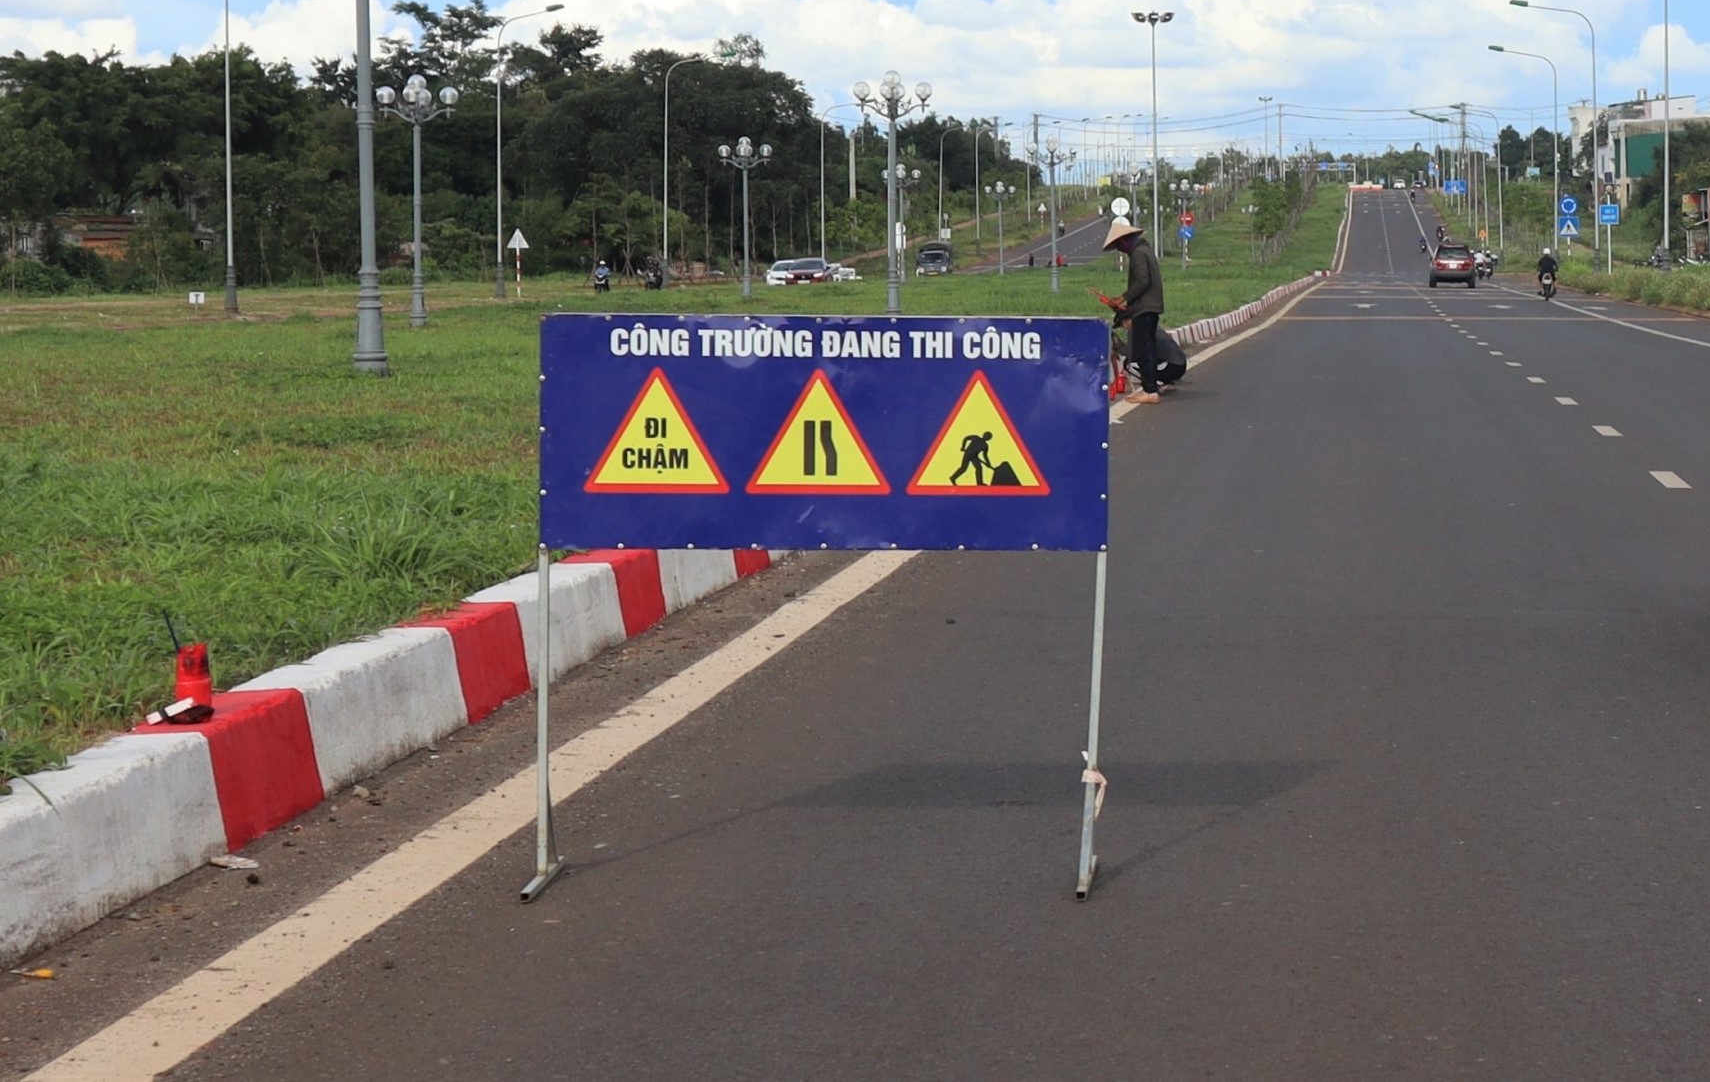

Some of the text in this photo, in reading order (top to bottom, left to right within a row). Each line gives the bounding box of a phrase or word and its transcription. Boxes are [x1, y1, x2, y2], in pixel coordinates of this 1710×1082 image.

[610, 322, 1041, 360] CÔNG TRƯỜNG ĐANG THI CÔNG
[644, 417, 667, 439] ĐI
[622, 443, 689, 474] CHẬM
